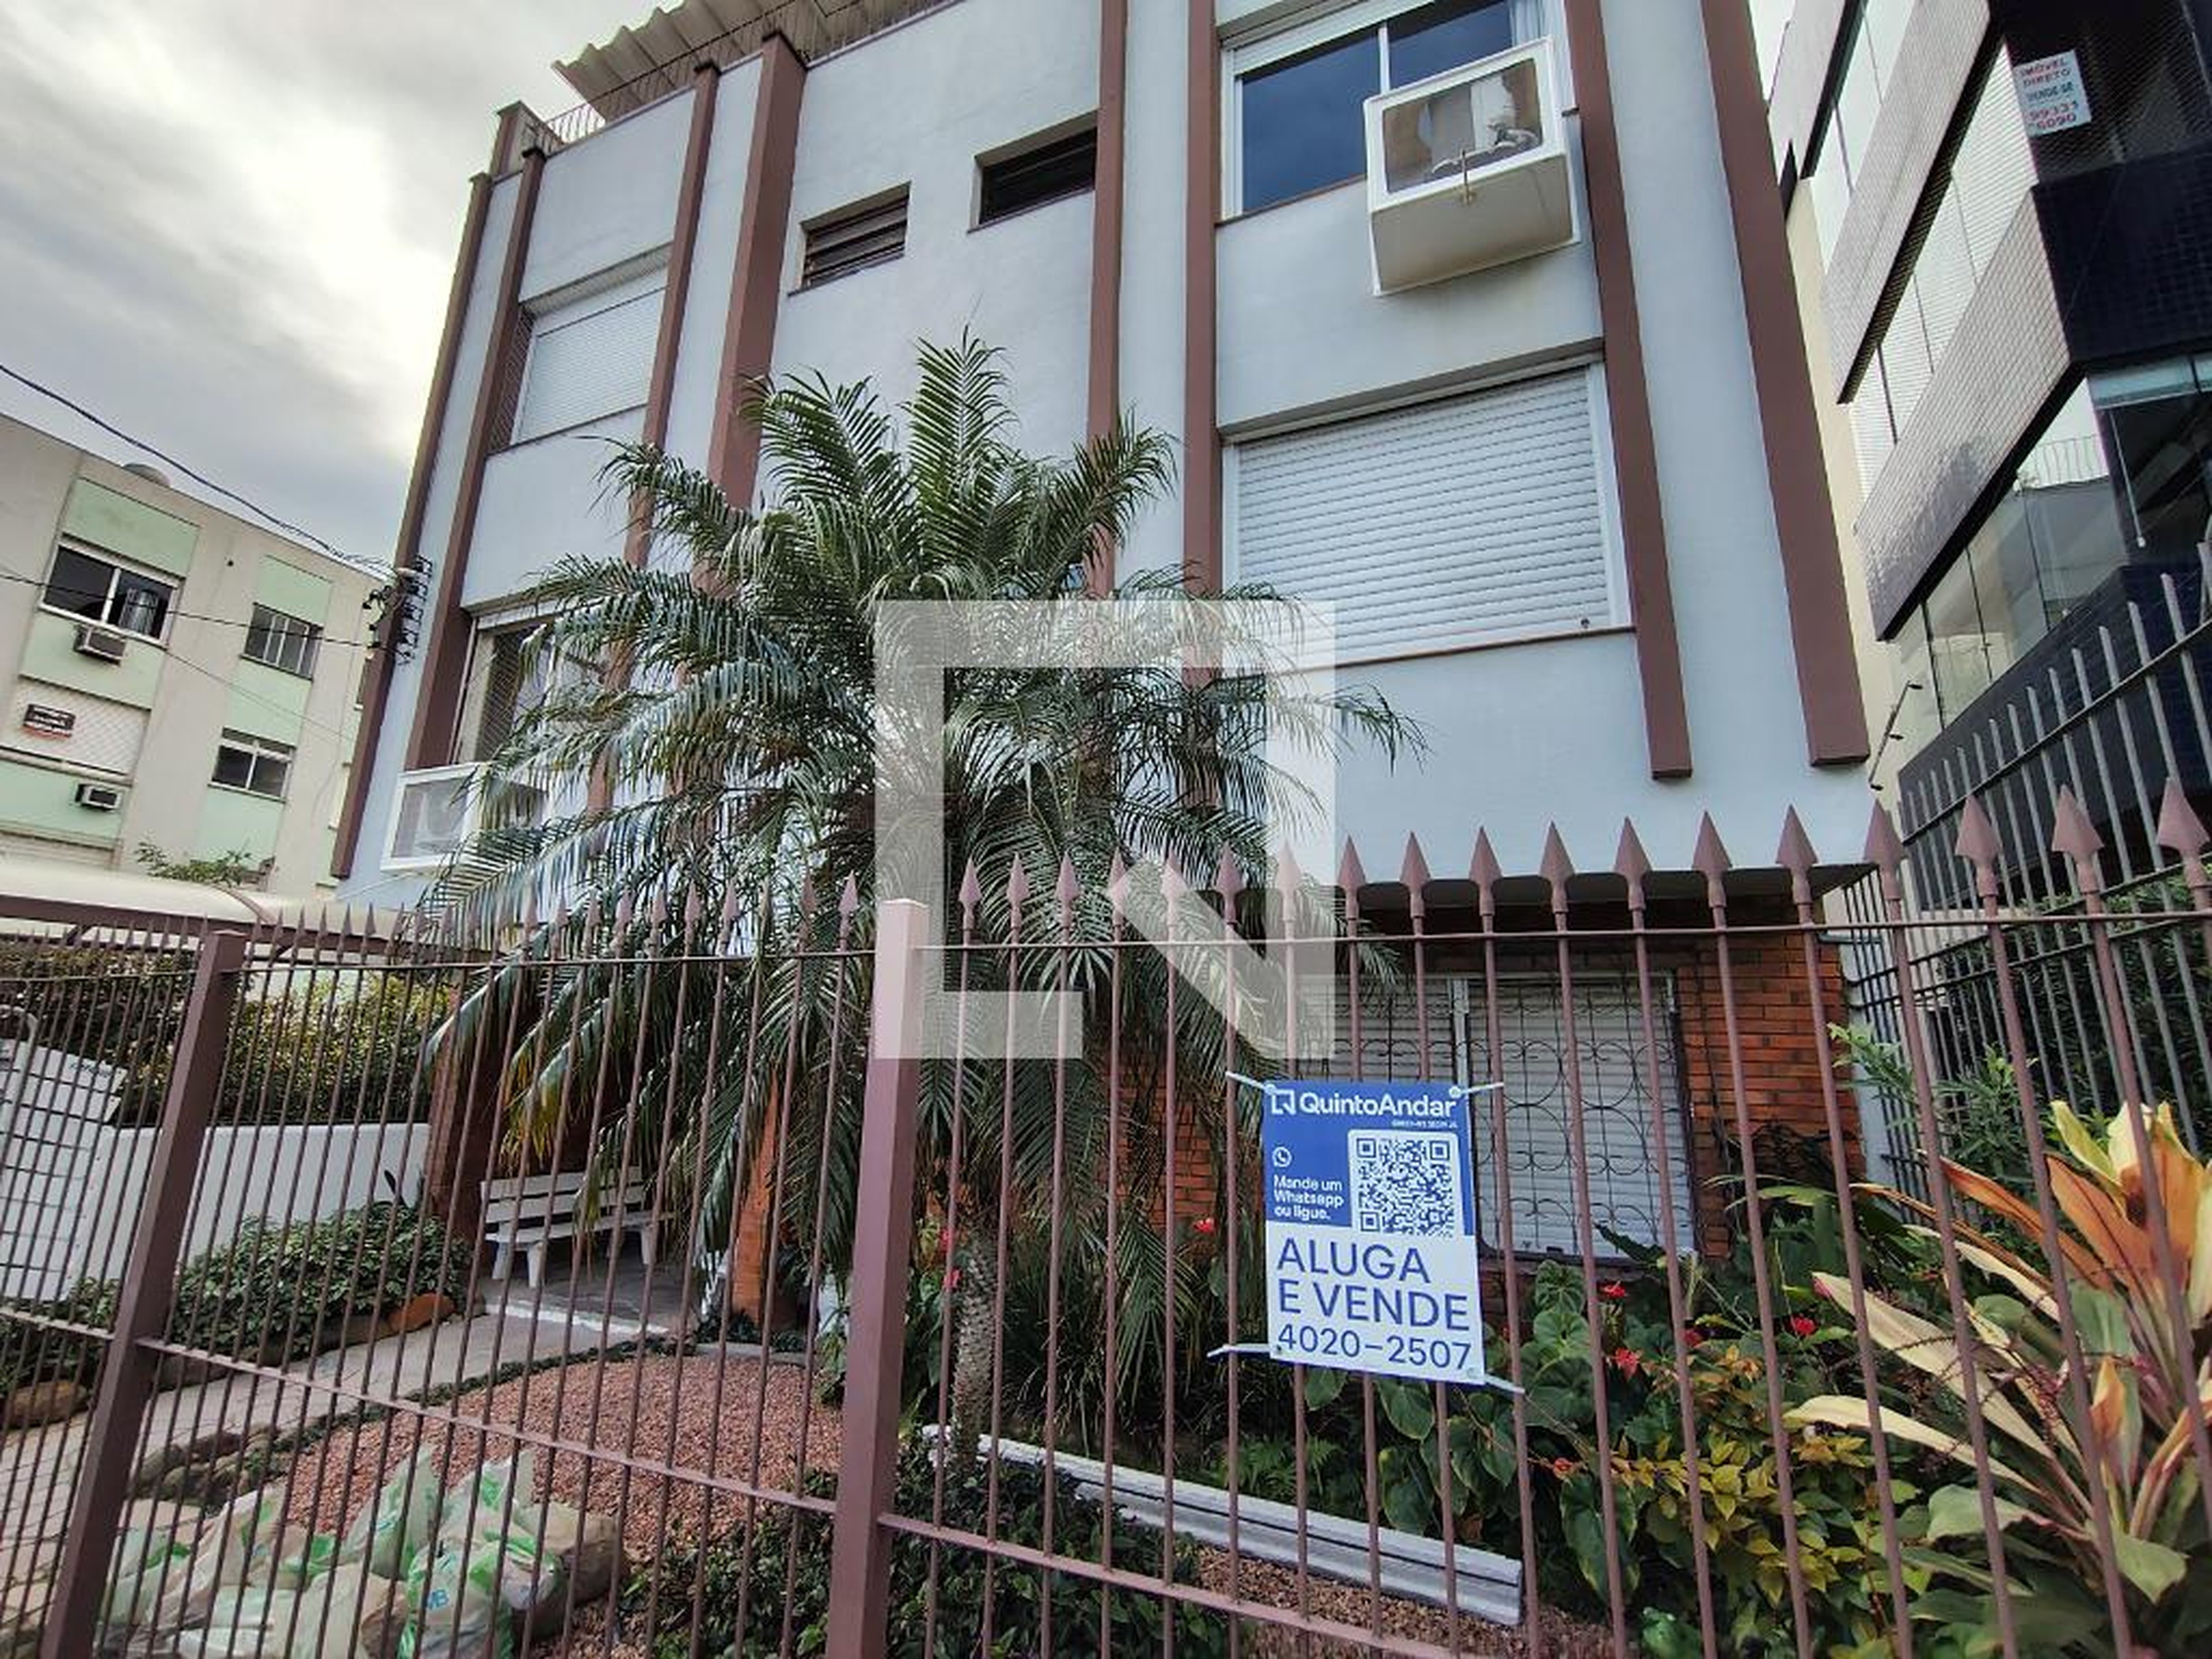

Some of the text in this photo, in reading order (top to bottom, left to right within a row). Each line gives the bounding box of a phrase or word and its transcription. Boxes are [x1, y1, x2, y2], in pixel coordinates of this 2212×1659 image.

[1300, 1093, 1457, 1118] QuintoAndar
[1274, 1174, 1342, 1192] Mande um
[1274, 1206, 1291, 1217] ou
[1277, 1237, 1431, 1283] ALUGA
[1278, 1278, 1470, 1331] E VENDE
[1278, 1324, 1471, 1370] 4020-2507
